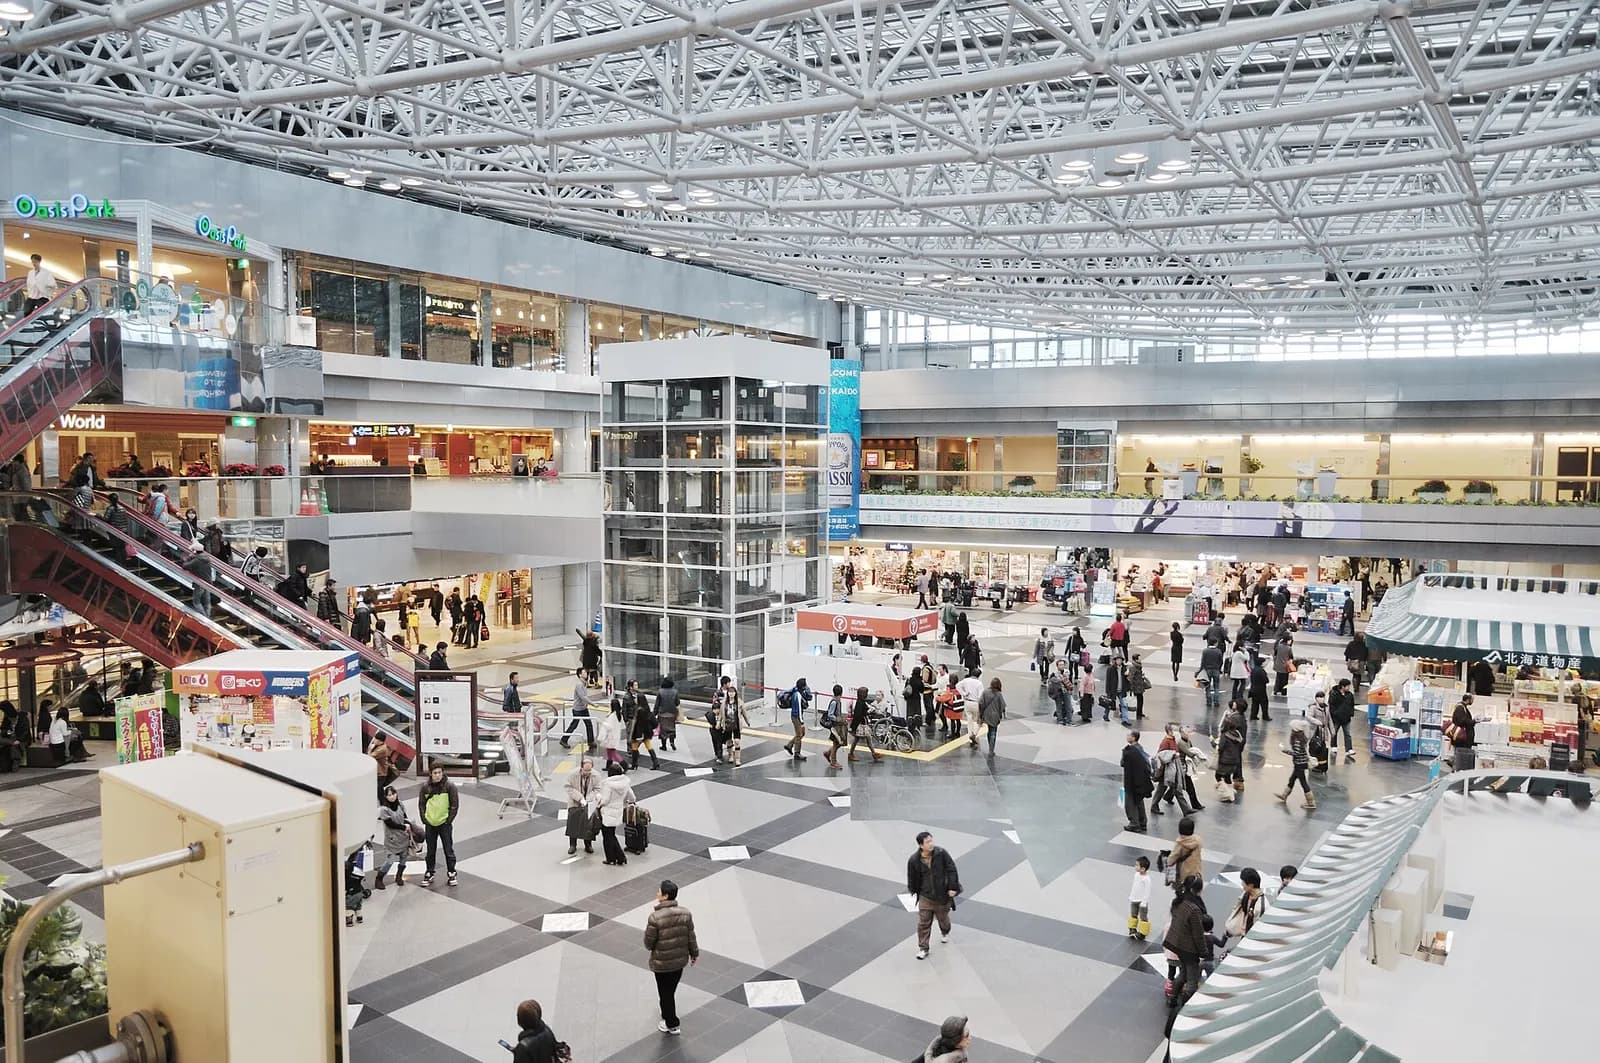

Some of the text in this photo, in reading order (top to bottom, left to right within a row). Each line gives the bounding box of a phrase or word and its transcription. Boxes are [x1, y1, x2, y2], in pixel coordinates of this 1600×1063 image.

[14, 193, 116, 219] Oasis Park
[195, 214, 248, 251] Oasis Park
[60, 414, 106, 430] World
[1504, 652, 1582, 670] 北海道物産
